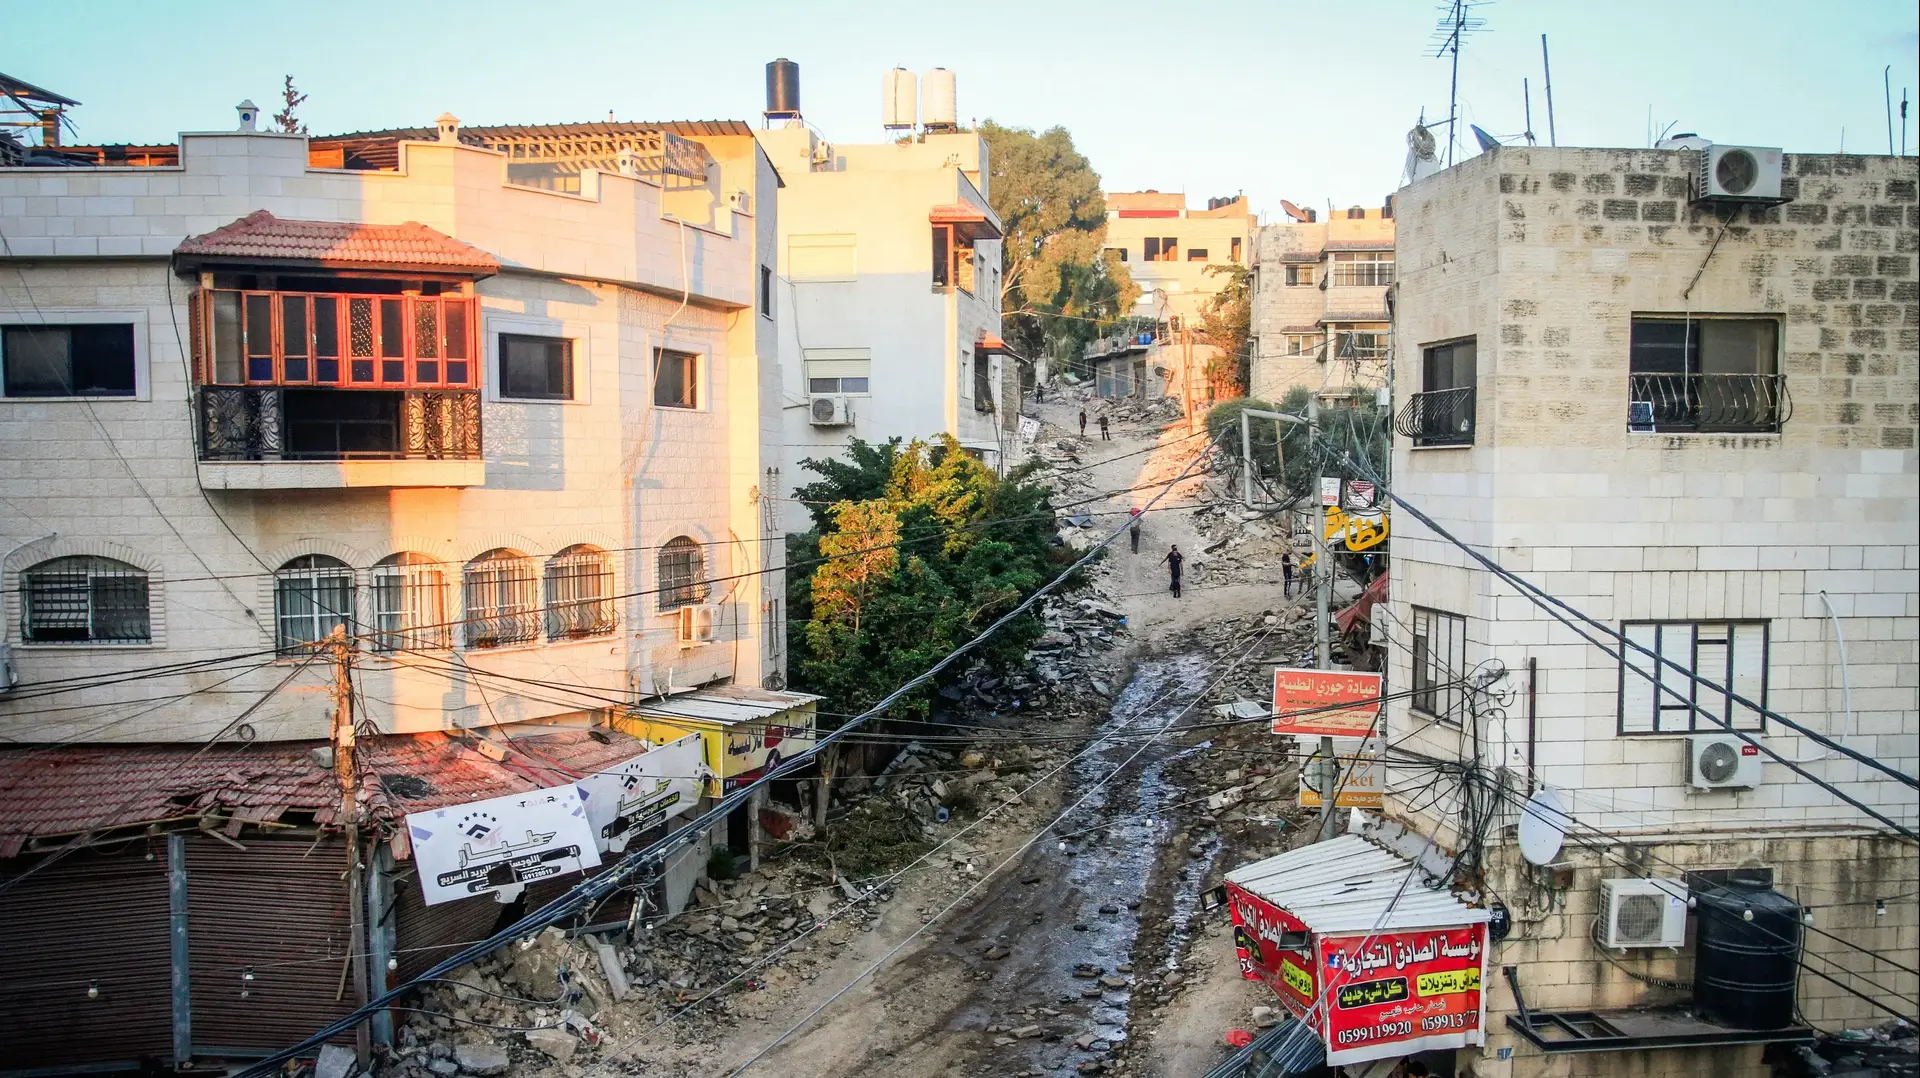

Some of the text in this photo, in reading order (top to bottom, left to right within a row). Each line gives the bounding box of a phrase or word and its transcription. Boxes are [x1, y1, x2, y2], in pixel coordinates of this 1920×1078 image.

[1279, 674, 1377, 698] عيادة جوري الطبية
[459, 830, 557, 868] طيار
[440, 871, 469, 886] السريع
[1338, 943, 1392, 978] التجارية
[1395, 936, 1438, 970] الصادق
[1342, 981, 1402, 1006] كل شيء جديد
[1420, 974, 1457, 993] وتنزيلات
[1338, 1020, 1413, 1044] 0599119920
